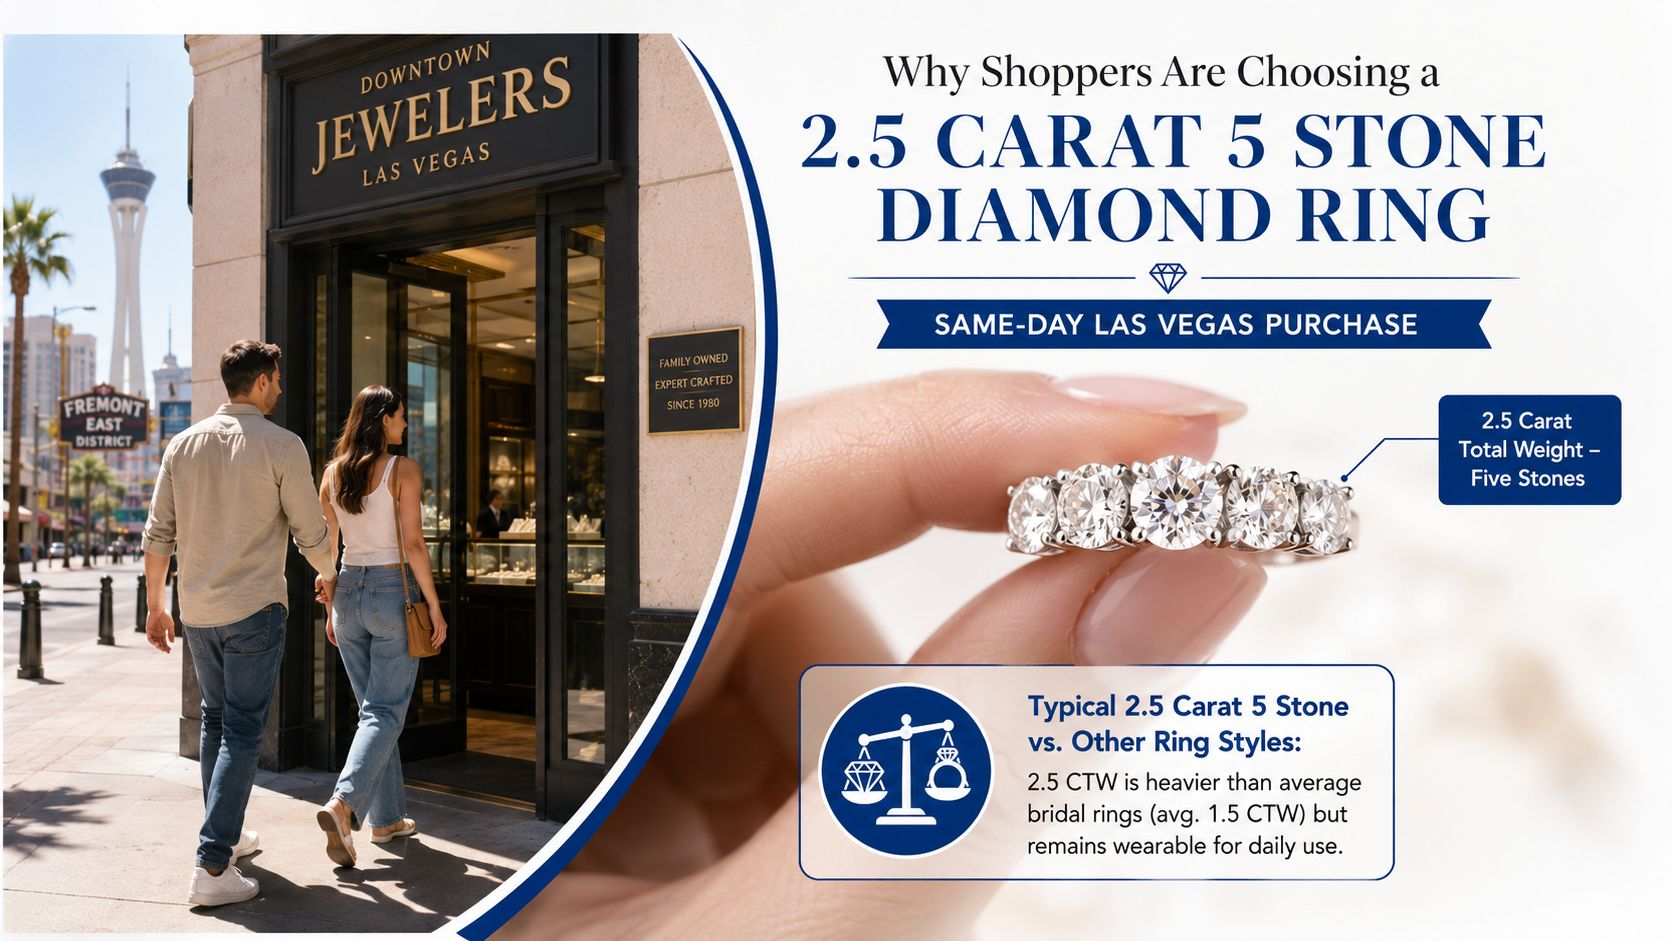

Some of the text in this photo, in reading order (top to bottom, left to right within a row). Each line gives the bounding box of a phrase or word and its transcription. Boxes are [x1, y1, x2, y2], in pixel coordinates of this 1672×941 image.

[360, 40, 490, 95] DOWNTOWN
[311, 56, 572, 175] JEWELERS
[363, 142, 490, 187] LAS VEGAS
[659, 353, 728, 368] FAMILY OWNED
[655, 375, 733, 390] EXPERT CRAFTED
[64, 397, 145, 418] FREMONT
[667, 397, 720, 411] SINCE 1980
[86, 417, 123, 432] EAST
[75, 435, 133, 447] DISTRICT
